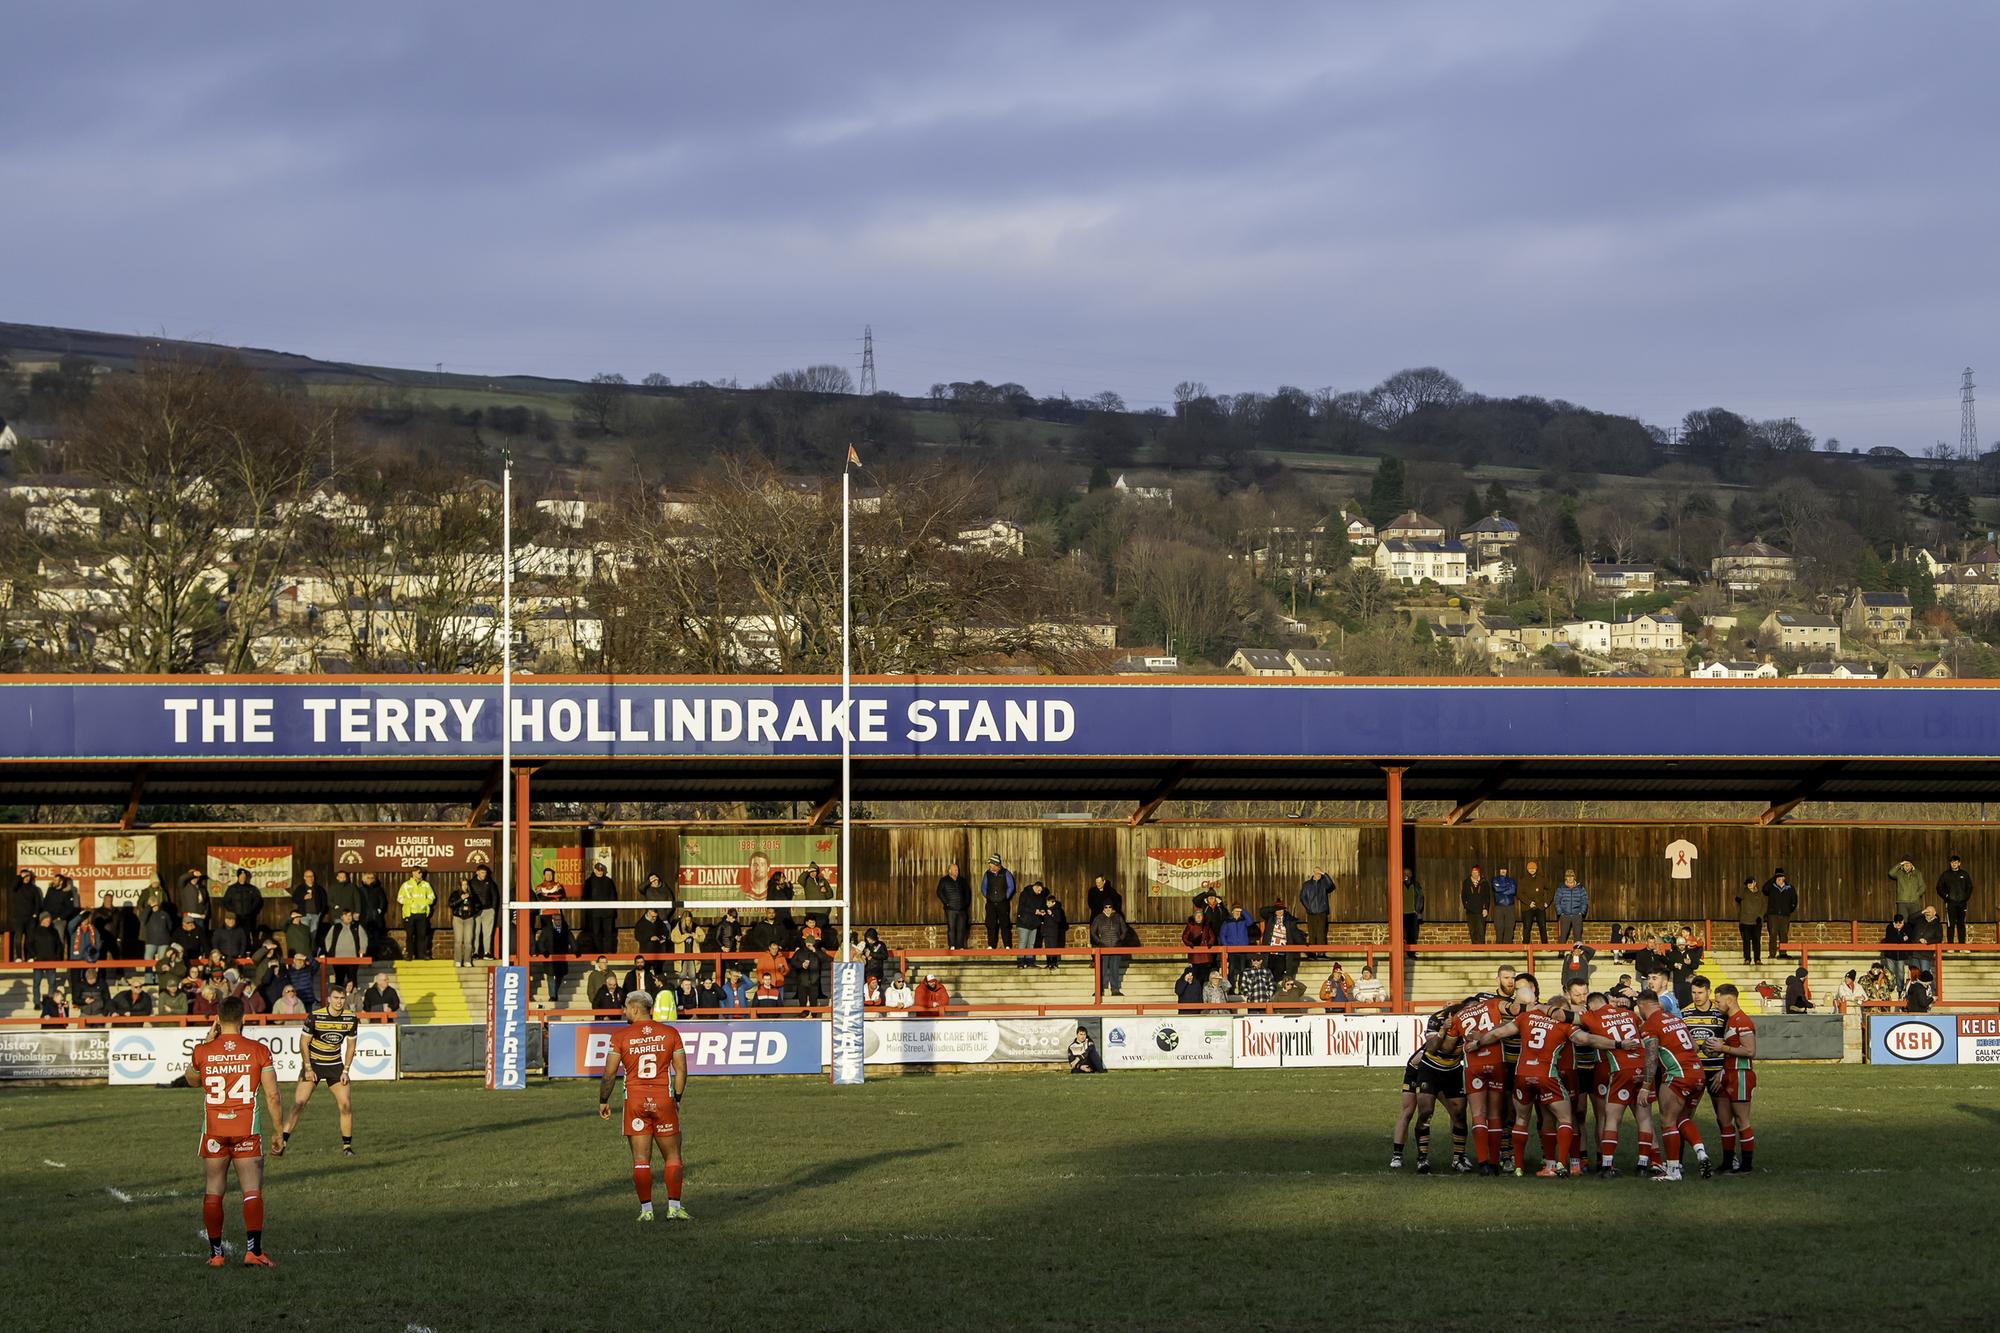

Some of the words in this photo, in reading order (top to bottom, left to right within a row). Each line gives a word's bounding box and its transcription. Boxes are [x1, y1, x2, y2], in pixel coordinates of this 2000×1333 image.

[164, 698, 274, 743] THE
[303, 698, 485, 743] TERRY
[511, 698, 888, 743] HOLLINDRAKE
[906, 698, 1076, 743] STAND
[396, 836, 428, 845] LEAGUE
[430, 836, 434, 844] 1
[20, 846, 76, 856] KEIGHLEY
[375, 845, 454, 858] CHAMPIONS
[401, 858, 428, 867] 2022
[60, 866, 114, 878] PASSION,
[117, 866, 153, 877] BELIEF
[698, 868, 739, 885] DANNY
[1169, 870, 1221, 880] Supporters
[1201, 881, 1221, 889] Club
[503, 972, 519, 1086] BETFRED
[1461, 1013, 1495, 1037] 24
[1528, 1020, 1554, 1031] RYDER
[1962, 1020, 2000, 1034] KEIG
[629, 1035, 666, 1045] BENTLEY
[886, 1032, 918, 1042] LAUREL
[920, 1032, 942, 1042] BANK
[943, 1032, 964, 1041] CARE
[966, 1032, 989, 1041] HOME
[1528, 1028, 1547, 1049] 3
[1607, 1024, 1638, 1044] 12
[1675, 1029, 1693, 1050] 9
[1896, 1032, 1932, 1050] KSH
[584, 1031, 788, 1067] BFRED
[629, 1044, 666, 1055] FARRELL
[886, 1044, 902, 1053] Main
[5, 1053, 57, 1063] Upholstery
[70, 1050, 104, 1061] 01535
[112, 1053, 157, 1061] STELL
[207, 1054, 251, 1062] BENTLEY
[206, 1065, 251, 1074] SAMMUT
[638, 1053, 657, 1079] 6
[205, 1075, 253, 1104] 34
